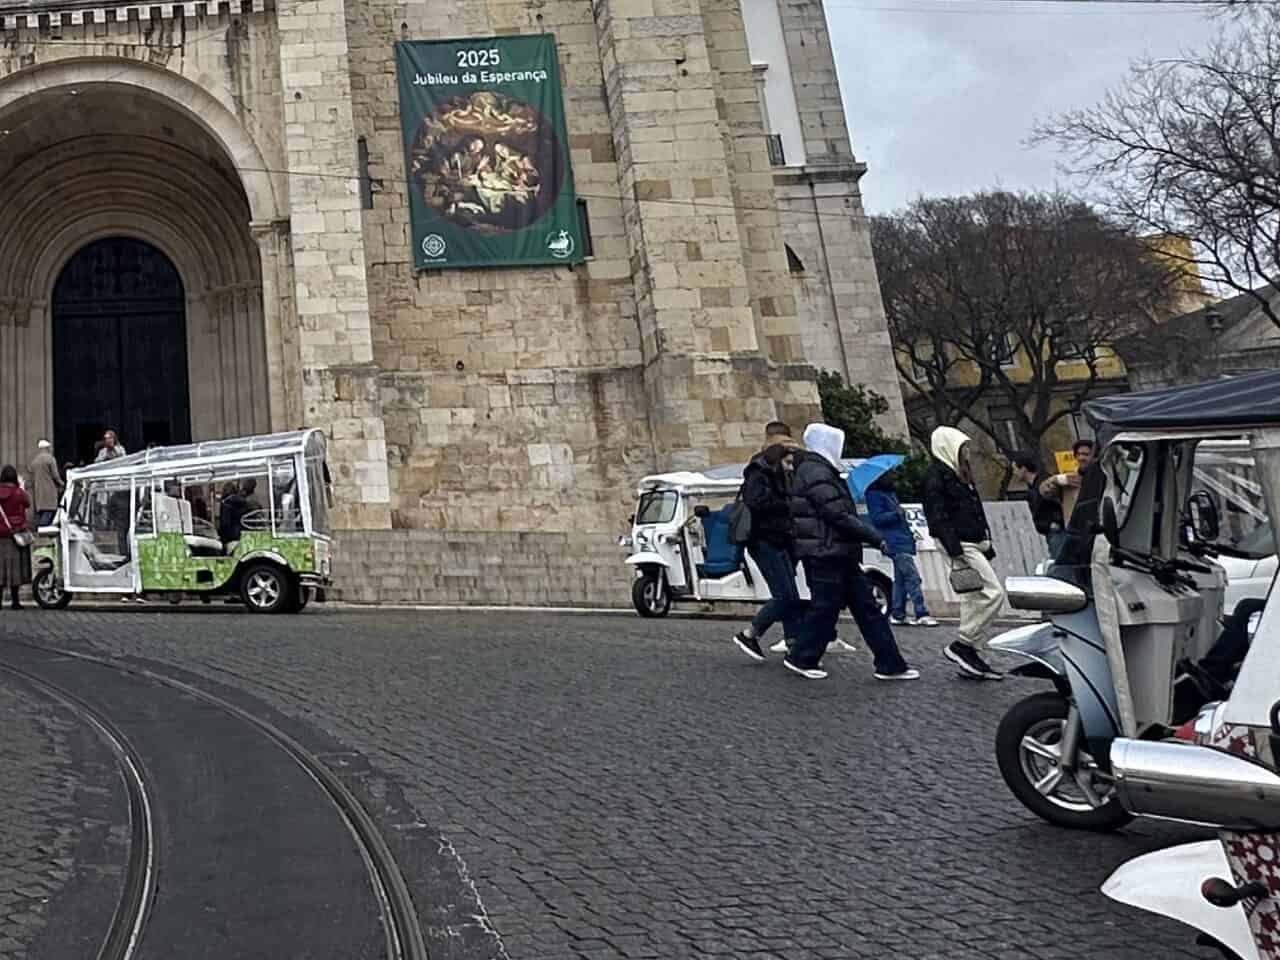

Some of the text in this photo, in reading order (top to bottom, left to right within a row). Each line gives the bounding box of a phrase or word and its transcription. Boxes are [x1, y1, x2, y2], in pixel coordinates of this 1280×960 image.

[456, 48, 501, 68] 2025
[412, 69, 548, 86] Jubileu da Esperança
